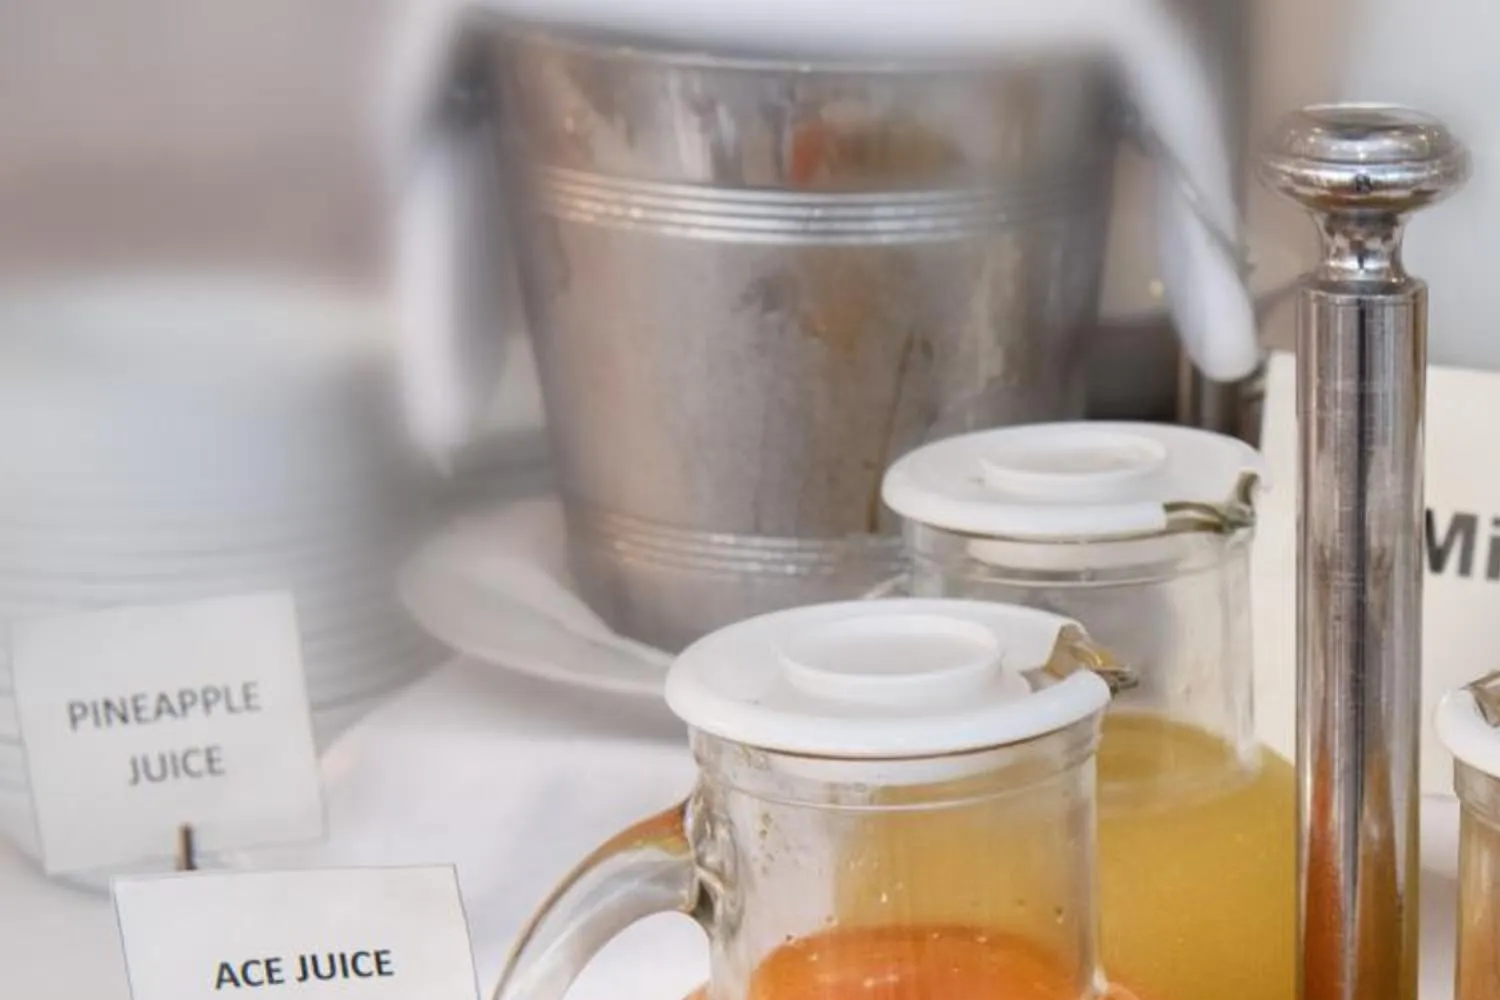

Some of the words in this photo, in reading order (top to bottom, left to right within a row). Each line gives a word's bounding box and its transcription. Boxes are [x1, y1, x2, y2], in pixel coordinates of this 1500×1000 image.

[68, 681, 262, 731] PINEAPPLE
[129, 745, 226, 786] JUICE
[215, 957, 284, 990] ACE
[296, 949, 395, 982] JUICE
